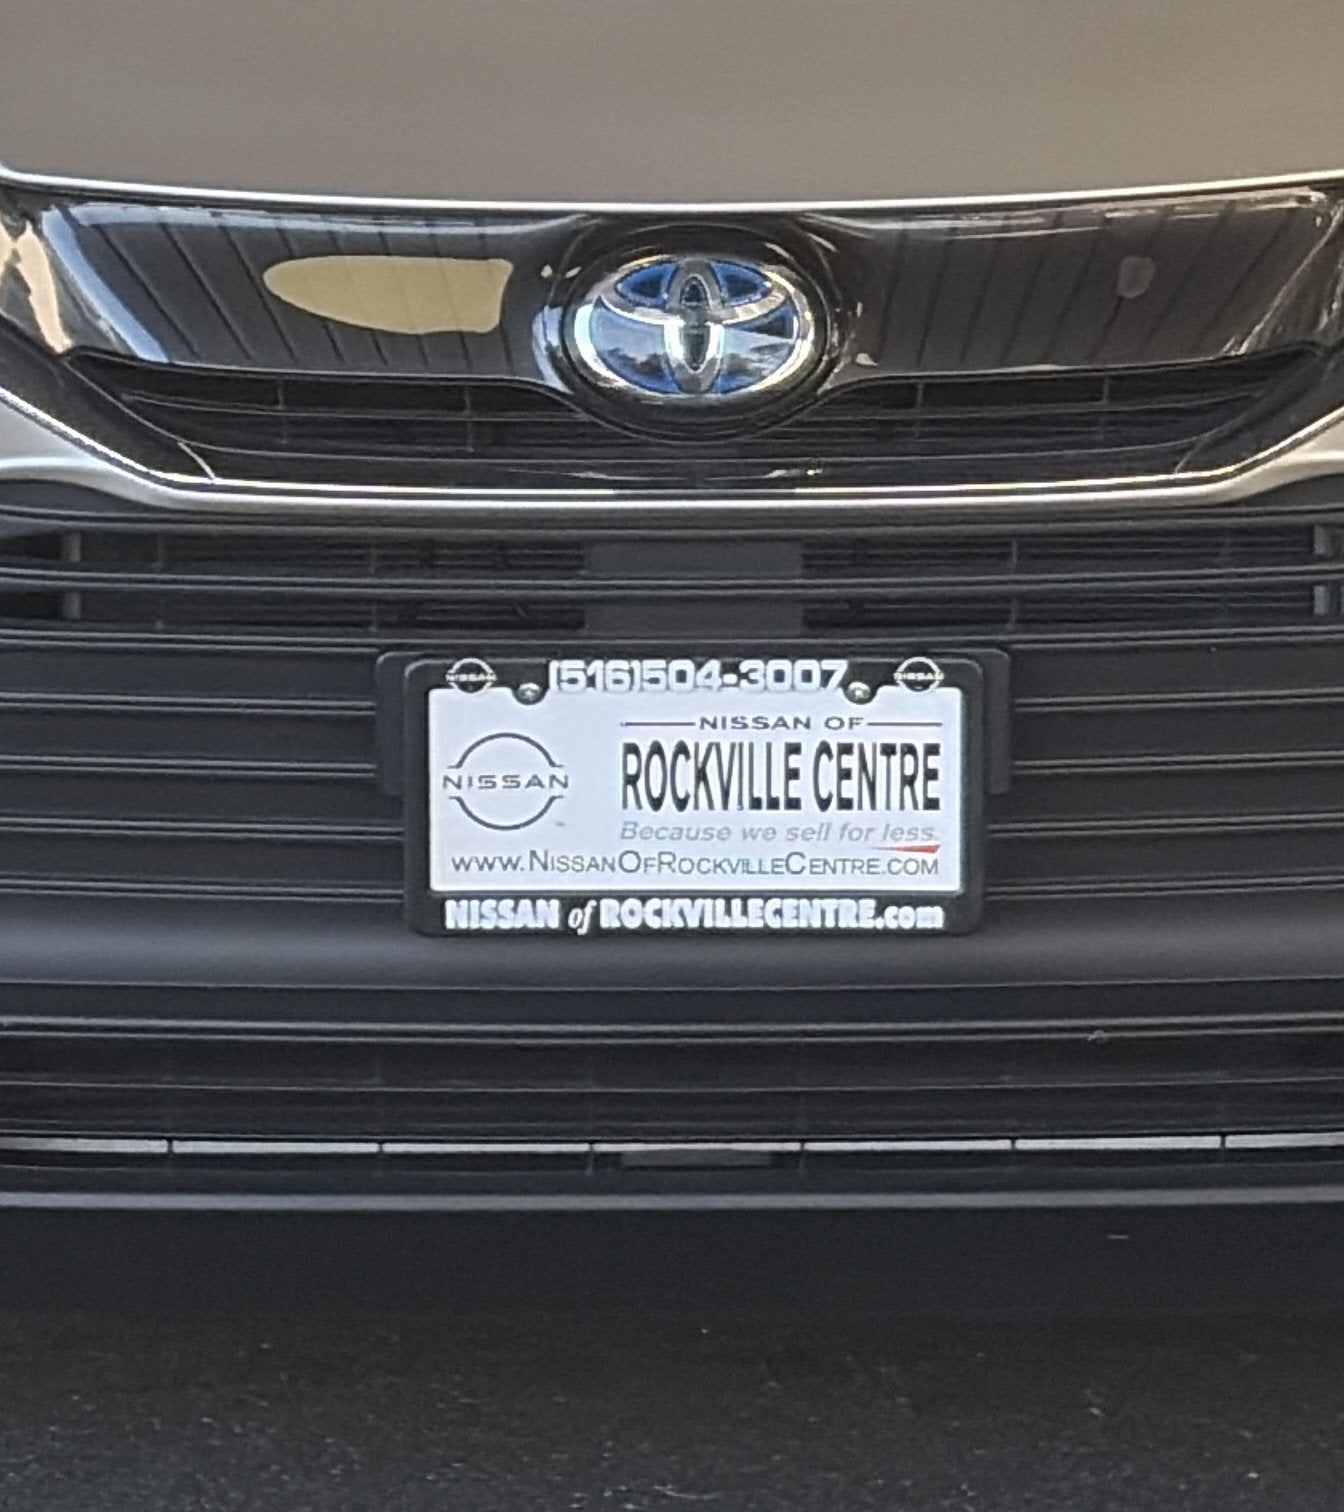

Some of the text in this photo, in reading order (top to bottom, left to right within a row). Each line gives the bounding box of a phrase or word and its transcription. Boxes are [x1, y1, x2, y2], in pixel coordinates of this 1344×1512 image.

[699, 716, 865, 731] NISSAN OF
[442, 774, 569, 790] NISSAN
[621, 739, 942, 813] ROCKVILLE CENTRE
[620, 821, 731, 842] Because
[741, 826, 776, 842] we
[784, 822, 831, 842] sell
[839, 822, 876, 842] for
[444, 897, 946, 935] NISSAN of ROCKVILLECENTRE.com
